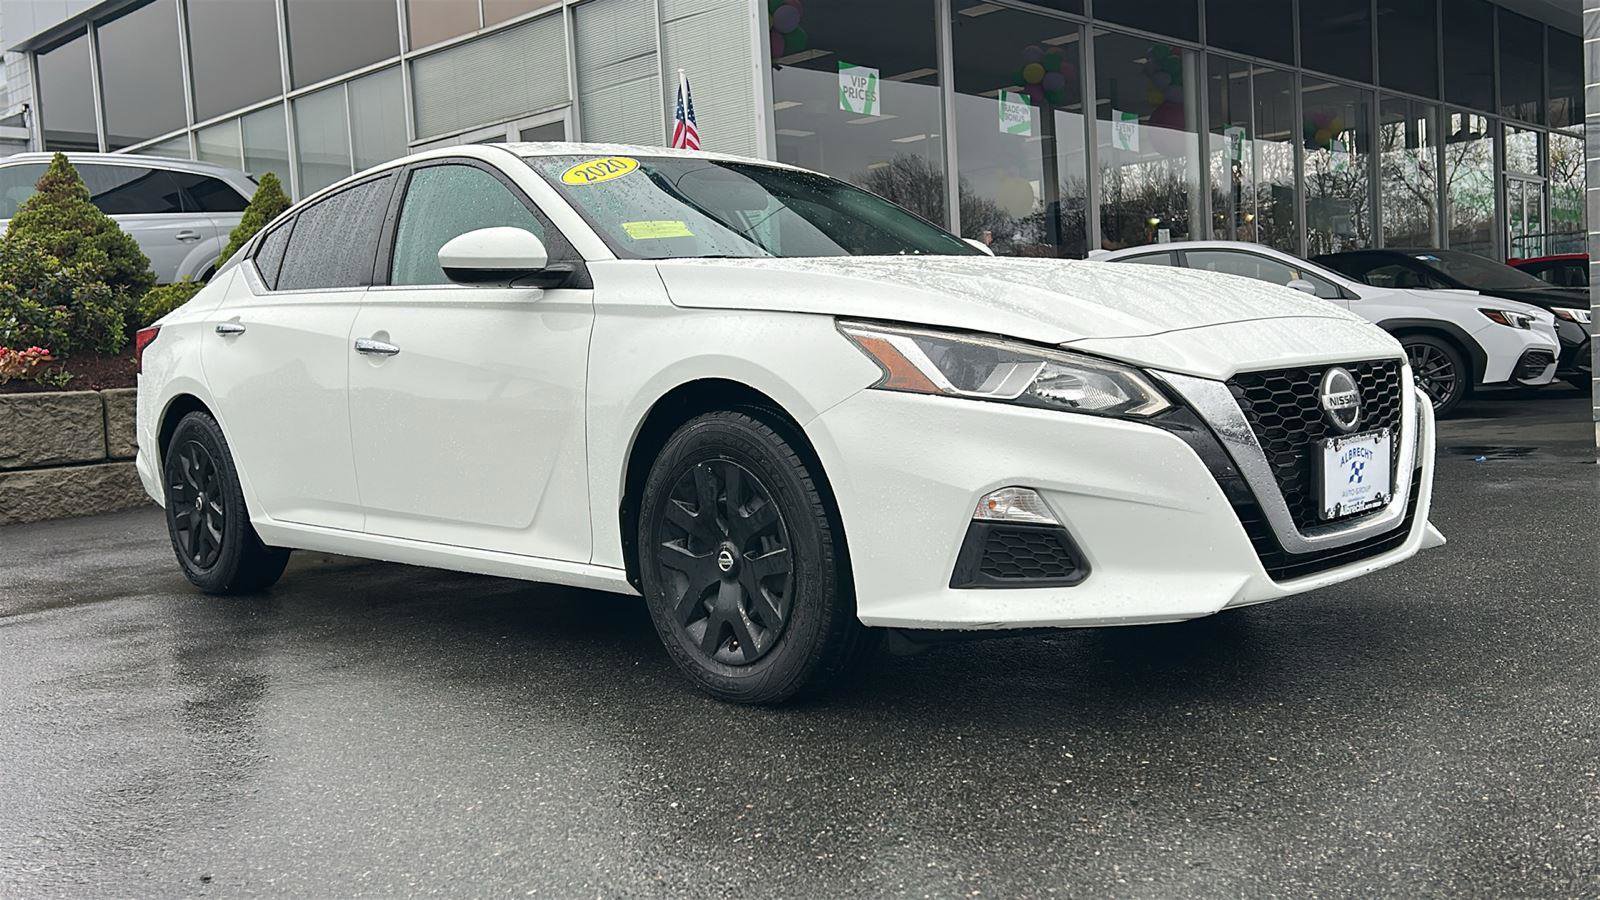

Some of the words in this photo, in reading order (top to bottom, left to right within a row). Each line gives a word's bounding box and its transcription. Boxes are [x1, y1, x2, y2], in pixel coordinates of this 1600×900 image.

[851, 75, 867, 88] VIP
[843, 85, 876, 102] PRICES
[575, 159, 628, 182] 2020
[1329, 393, 1358, 407] NISSAN
[1340, 447, 1374, 468] ALBRECHT
